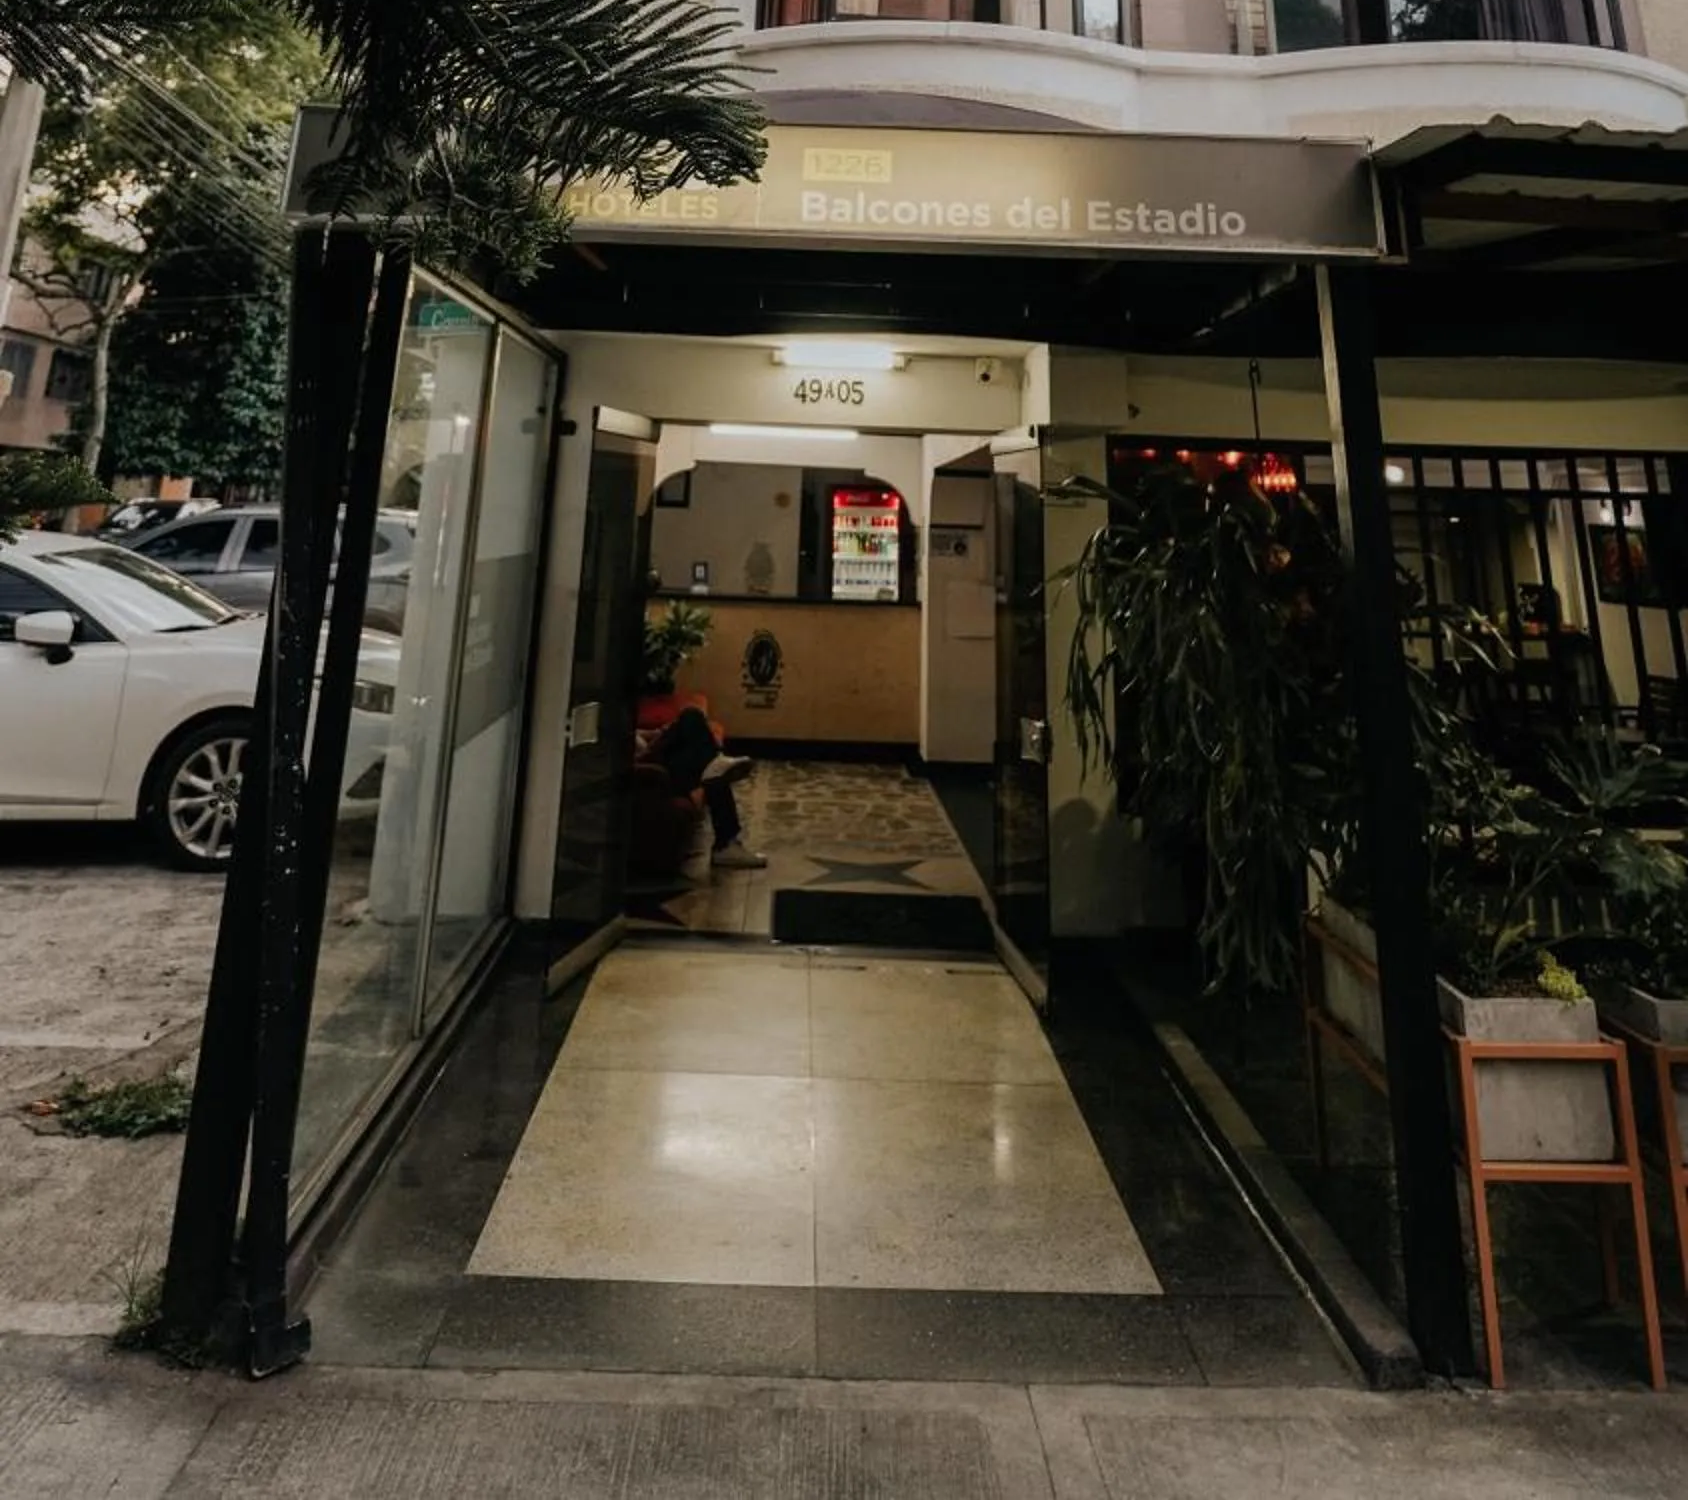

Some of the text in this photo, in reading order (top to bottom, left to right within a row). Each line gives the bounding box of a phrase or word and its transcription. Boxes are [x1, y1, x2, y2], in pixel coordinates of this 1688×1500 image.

[809, 153, 883, 178] 1226
[802, 190, 1247, 236] Balcones del Estadio
